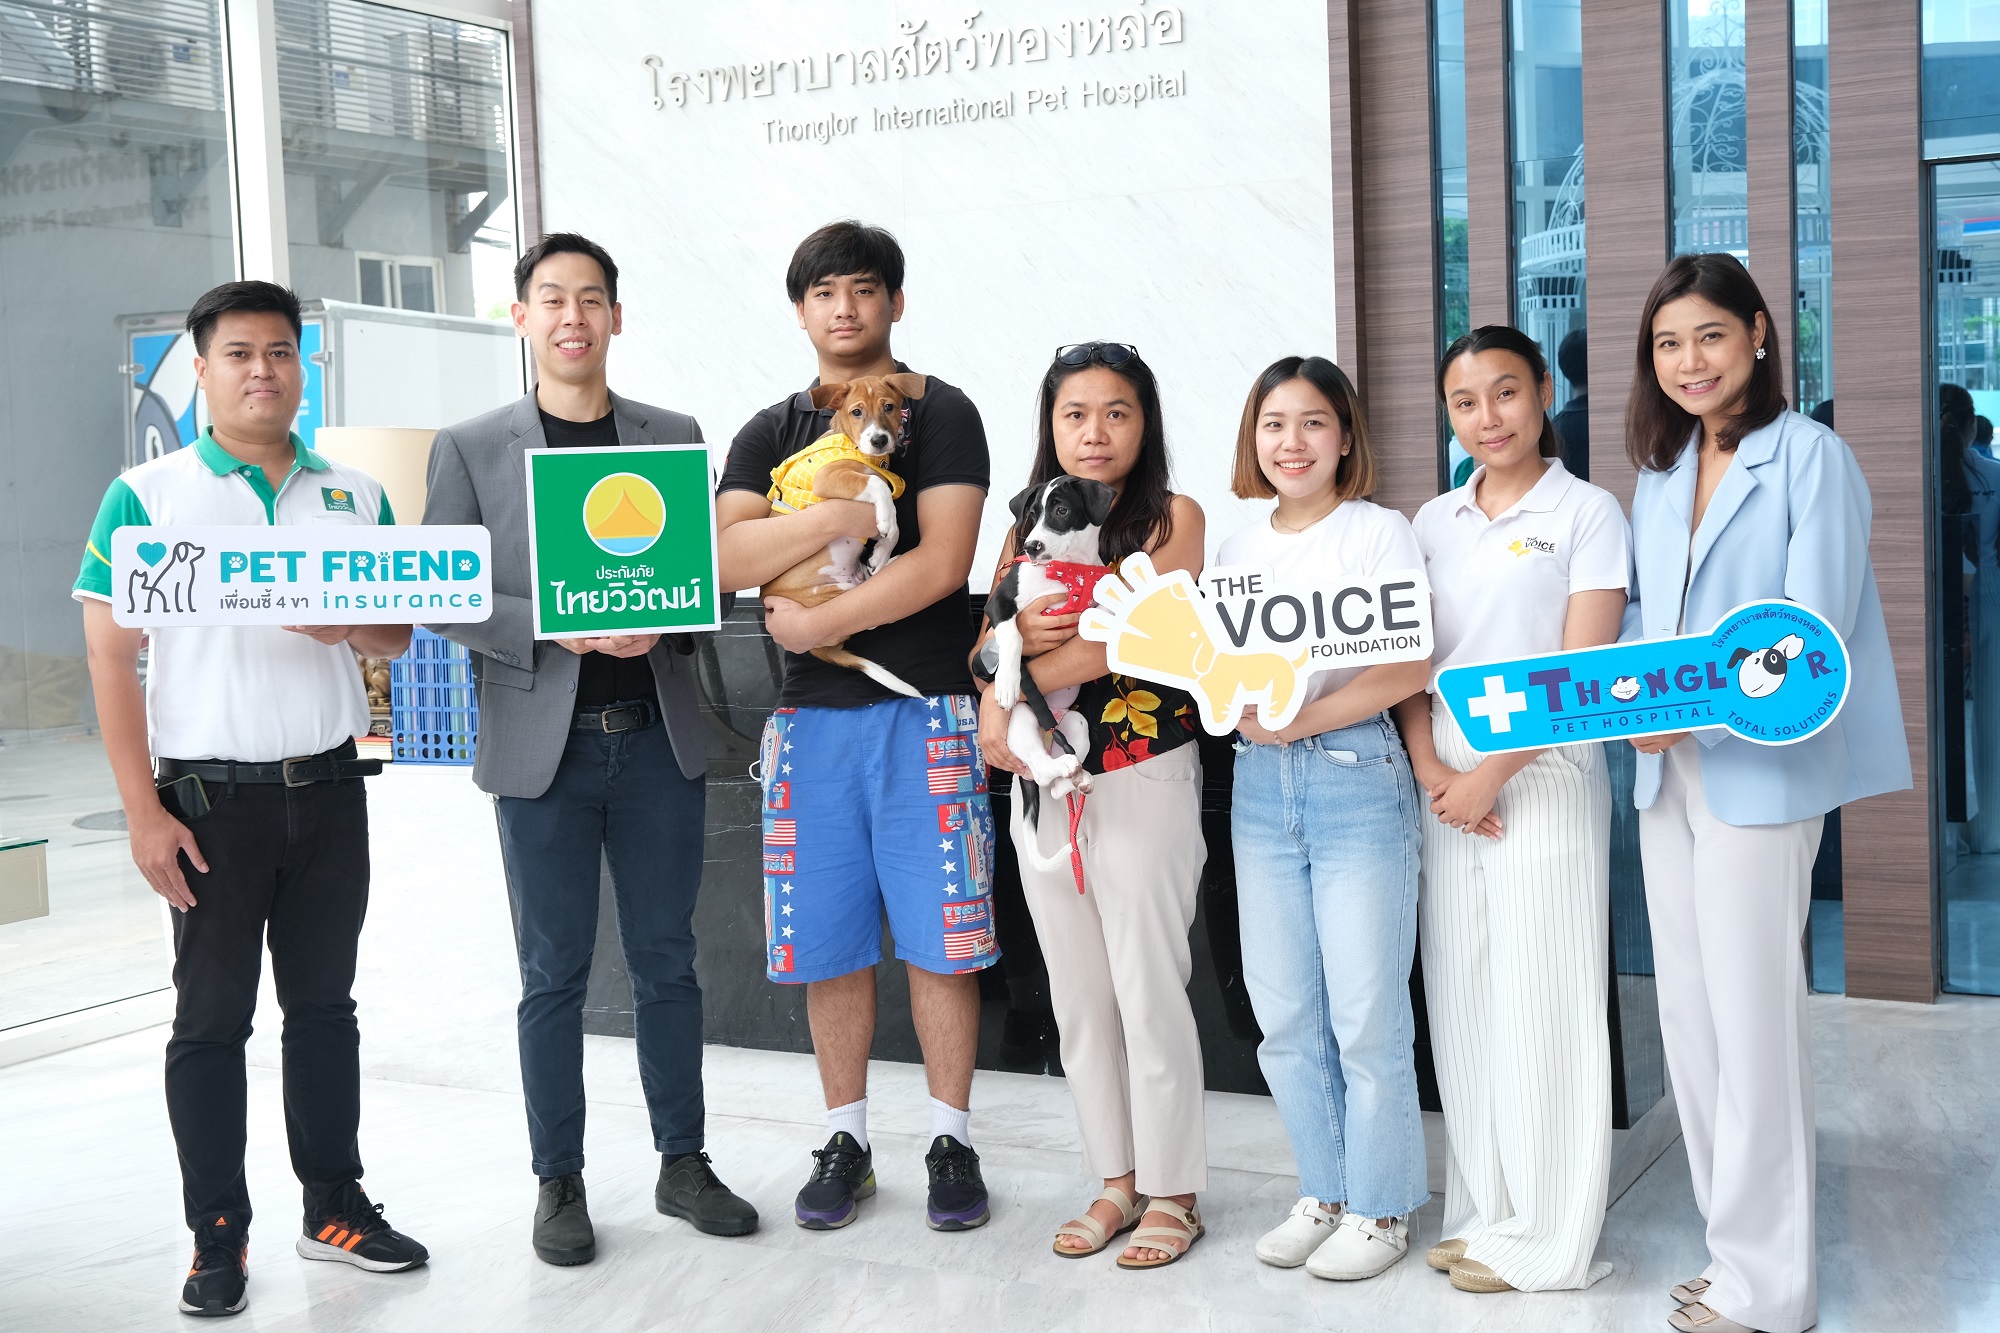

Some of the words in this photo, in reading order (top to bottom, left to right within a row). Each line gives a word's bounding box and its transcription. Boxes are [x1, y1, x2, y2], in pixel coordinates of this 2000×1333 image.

[641, 0, 1184, 110] โรงพยาบาลสัตว์ทองหล่อ
[763, 112, 858, 145] Thonglor
[874, 91, 1014, 132] International
[1027, 85, 1067, 114] Pet
[1083, 69, 1185, 109] Hospital
[1525, 540, 1555, 551] VOICE
[220, 551, 306, 583] PET
[595, 564, 655, 580] ประกันภัย
[550, 577, 701, 615] ไทยวิวัฒน์
[1211, 573, 1264, 597] THE
[220, 588, 271, 610] เพื่อนซี้
[276, 596, 287, 609] 4
[291, 596, 309, 609] ขา
[323, 591, 482, 609] insurance
[1215, 580, 1420, 648] VOICE
[1711, 607, 1822, 649] โรงพยาบาลสัตว์ทองหล่อ
[1311, 634, 1421, 658] FOUNDATION
[1552, 720, 1588, 735] PET
[1603, 706, 1715, 729] HOSPITAL
[1728, 710, 1767, 736] TOTAL
[1774, 691, 1837, 736] SOLUTIONS
[927, 739, 972, 760] USA
[944, 904, 987, 925] USA
